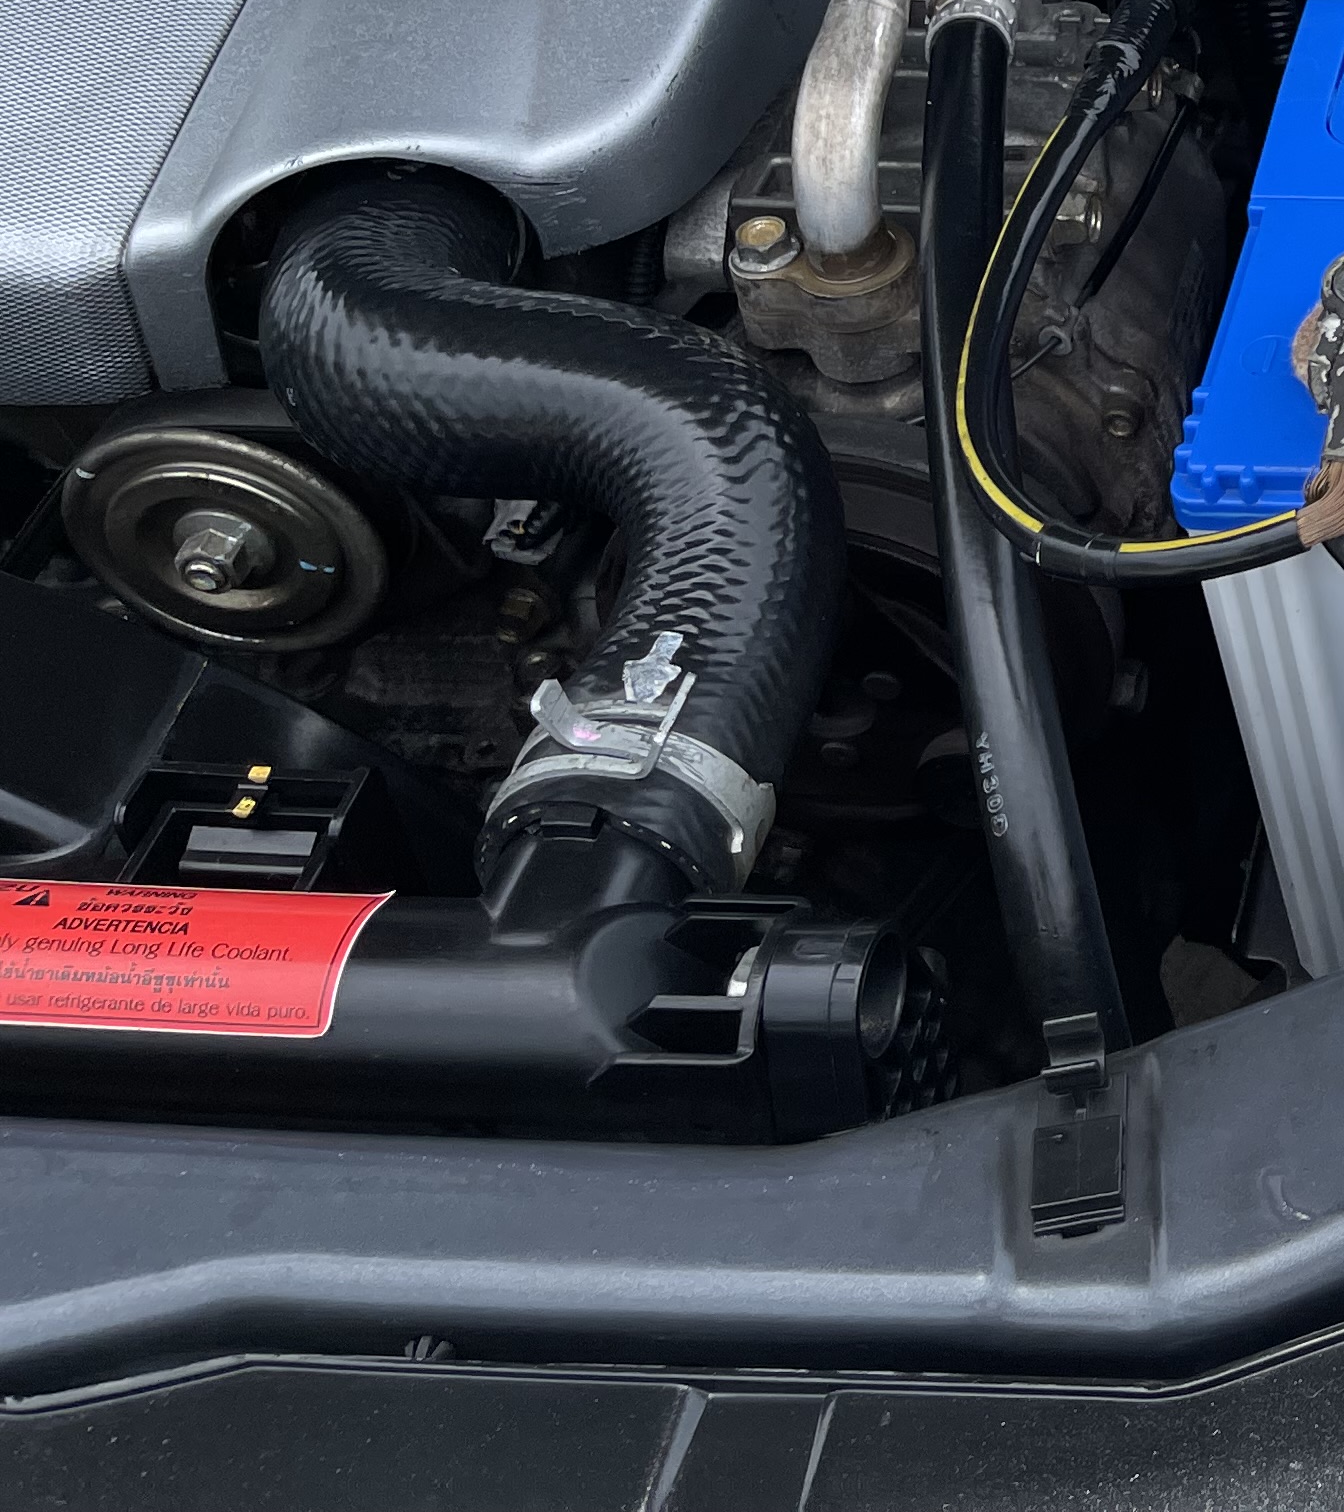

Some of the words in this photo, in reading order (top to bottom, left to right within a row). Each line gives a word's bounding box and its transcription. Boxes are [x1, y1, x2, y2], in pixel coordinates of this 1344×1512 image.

[52, 916, 191, 936] ADVERTENCIA
[110, 940, 162, 960] Long
[167, 941, 204, 959] Life
[211, 942, 294, 963] Coolant.
[6, 993, 43, 1007] usar
[48, 993, 145, 1013] refrigerante
[151, 998, 173, 1014] de
[177, 998, 220, 1019] large
[226, 1002, 261, 1019] vida
[267, 1004, 311, 1021] puro.
